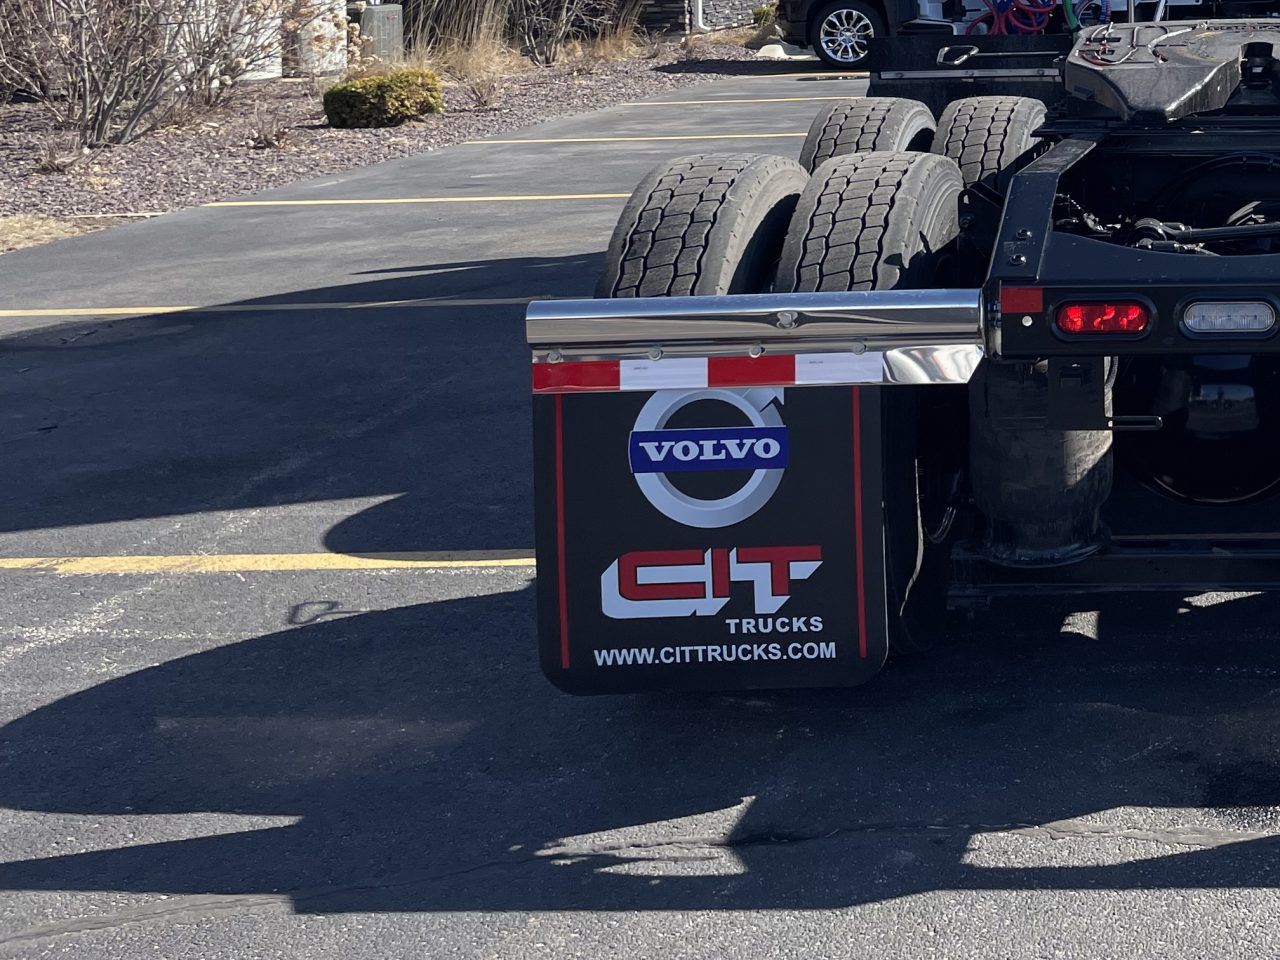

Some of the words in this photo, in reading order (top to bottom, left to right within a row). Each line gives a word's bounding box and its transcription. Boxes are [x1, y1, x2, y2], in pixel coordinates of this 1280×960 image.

[638, 437, 781, 462] VOLVO
[601, 545, 824, 619] CIT
[725, 616, 824, 634] TRUCKS
[593, 641, 837, 666] WWW.CITTRUCKS.COM
